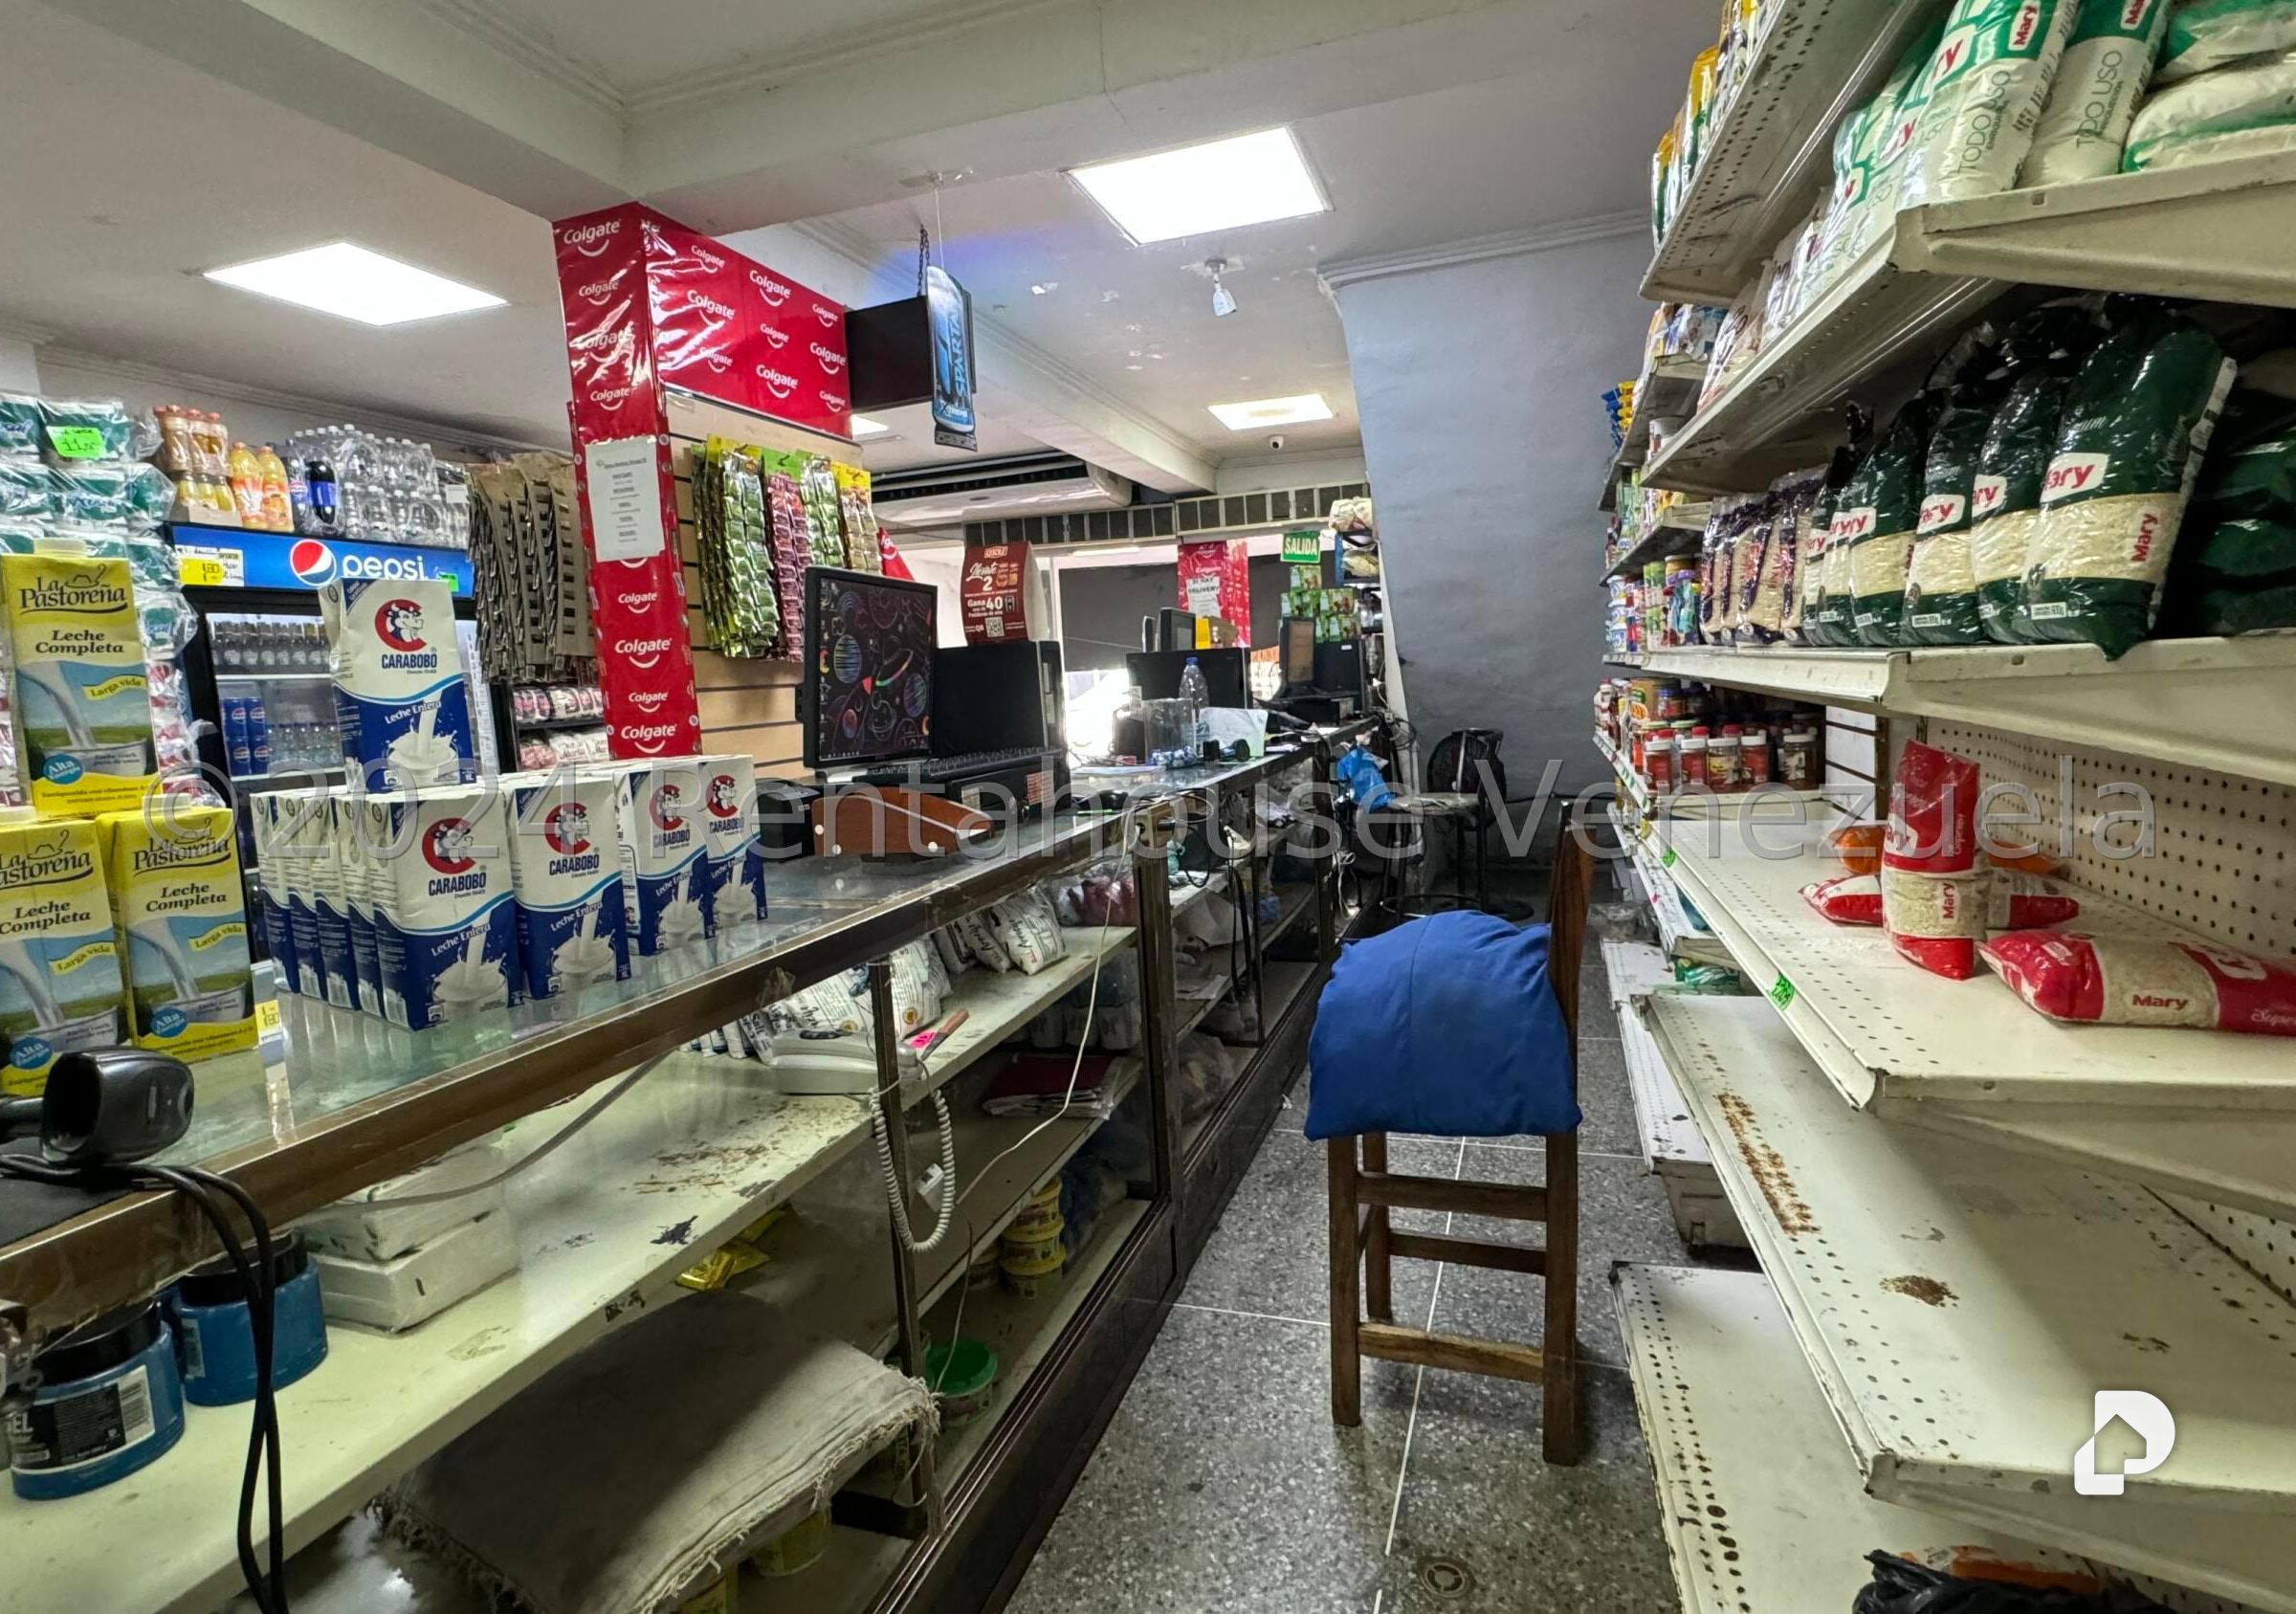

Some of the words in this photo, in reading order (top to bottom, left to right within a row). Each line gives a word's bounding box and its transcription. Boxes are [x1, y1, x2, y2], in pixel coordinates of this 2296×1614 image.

[2014, 6, 2037, 46] Mary
[2092, 51, 2123, 95] USO
[1958, 114, 1992, 171] TODO
[563, 220, 621, 244] Colgate
[691, 245, 725, 269] Colgate
[579, 280, 619, 297] Colgate
[749, 270, 791, 298] Colgate
[687, 290, 736, 320] Colgate
[812, 303, 839, 322] Colgate
[760, 323, 789, 343] Colgate
[810, 343, 847, 366] Colgate
[756, 365, 798, 389] Colgate
[590, 387, 631, 403] Colgate
[819, 390, 846, 407] Colgate
[1284, 537, 1318, 555] SALIDA
[2130, 514, 2158, 562] Mary
[342, 552, 425, 579] pepsi
[36, 577, 59, 592] La
[982, 576, 993, 591] 2
[19, 584, 126, 608] Pastoreña
[618, 591, 658, 605] Colgate
[967, 599, 985, 608] Gana
[986, 597, 1004, 609] 40
[52, 630, 105, 641] Leche
[35, 642, 124, 656] Completa
[615, 638, 672, 654] Colgate
[382, 653, 437, 669] CARABOBO
[91, 682, 120, 697] Larga
[120, 677, 142, 688] vida
[629, 691, 669, 703] Colgate
[384, 706, 412, 724] Leche
[412, 699, 442, 715] Entera
[621, 725, 676, 741] Colgate
[49, 759, 75, 774] Alta
[0, 851, 92, 883] astoreña
[549, 853, 600, 875] CARABOBO
[161, 882, 210, 898] Leche
[429, 872, 487, 896] CARABOBO
[655, 879, 673, 896] Leche
[14, 901, 71, 919] Leche
[145, 894, 227, 913] Completa
[1943, 882, 1955, 919] Mary
[0, 911, 92, 935] Completa
[550, 914, 575, 932] Leche
[575, 901, 603, 918] Entera
[195, 932, 222, 949] Larga
[221, 924, 242, 938] vida
[430, 935, 460, 957] Leche
[460, 923, 491, 942] Entera
[57, 949, 87, 972] Larga
[87, 943, 111, 959] vida
[2132, 995, 2189, 1010] Mary
[156, 1011, 180, 1028] Alta
[15, 1041, 44, 1059] Alta
